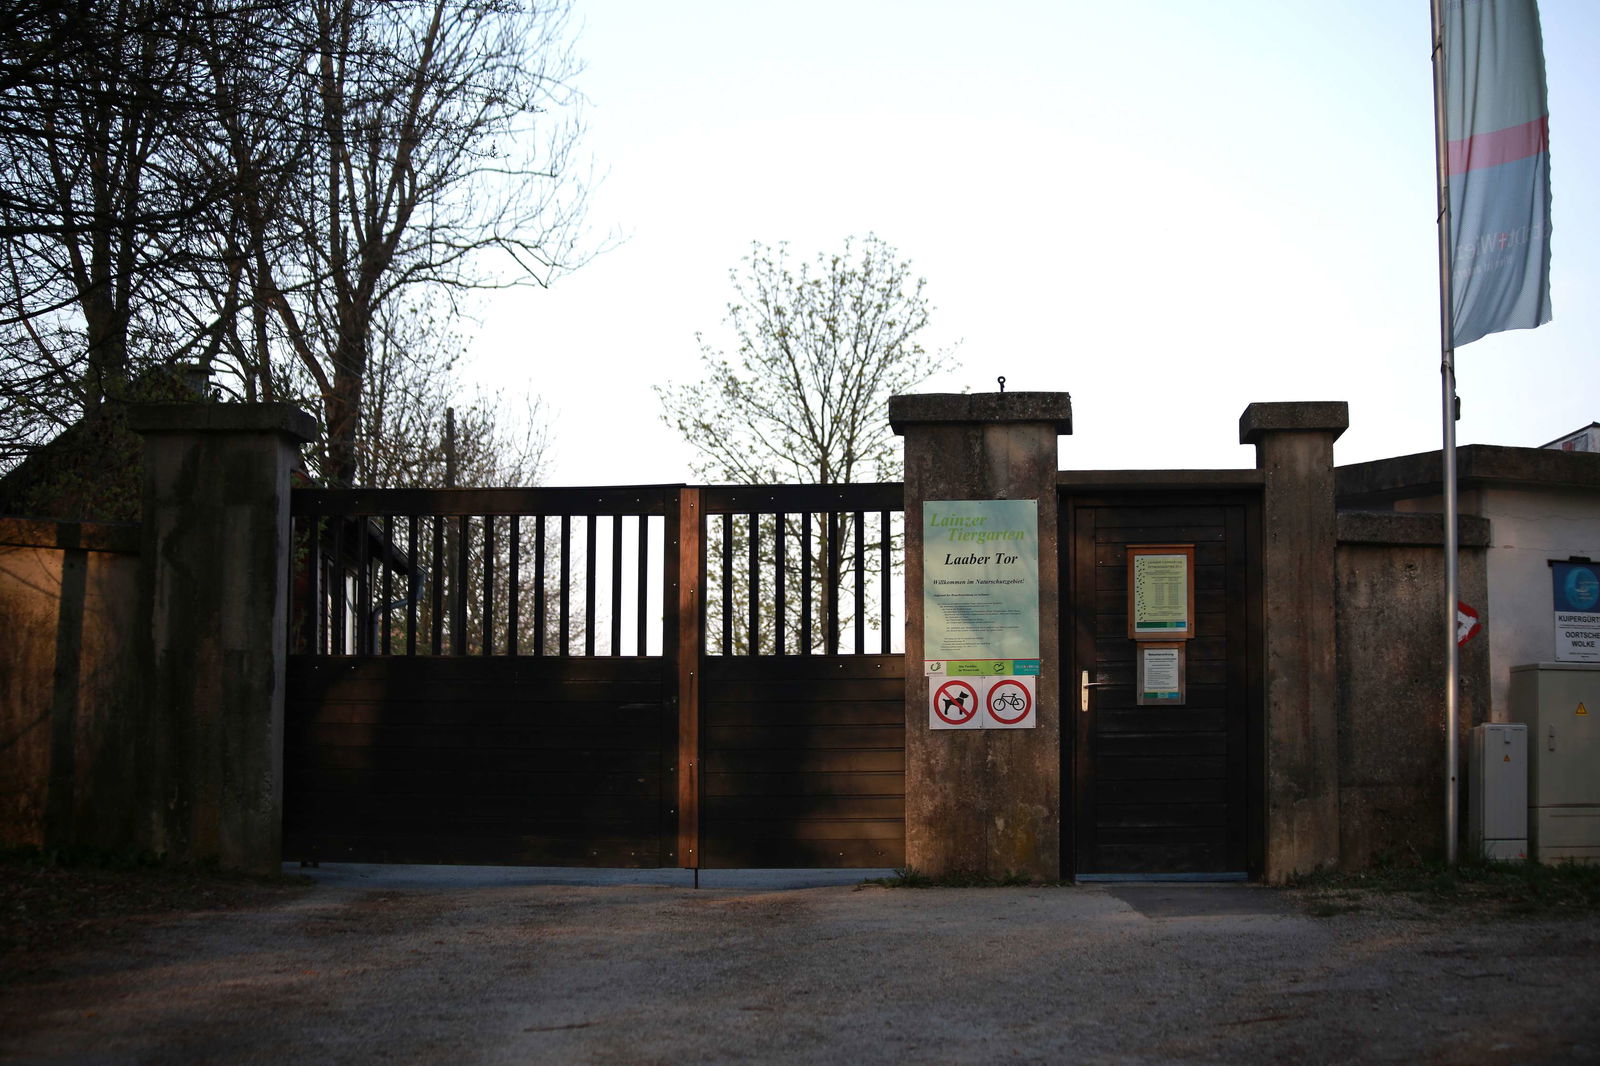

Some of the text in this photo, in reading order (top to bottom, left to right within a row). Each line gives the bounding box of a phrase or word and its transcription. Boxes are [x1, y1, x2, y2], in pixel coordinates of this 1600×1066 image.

[930, 513, 988, 528] Lainzer
[948, 528, 1025, 544] Tiergarten
[944, 552, 1018, 565] Laaber Tor
[1558, 615, 1600, 623] KUIPERGÜRT
[1565, 631, 1600, 639] OORTSCHE
[1571, 640, 1595, 648] WOLKE
